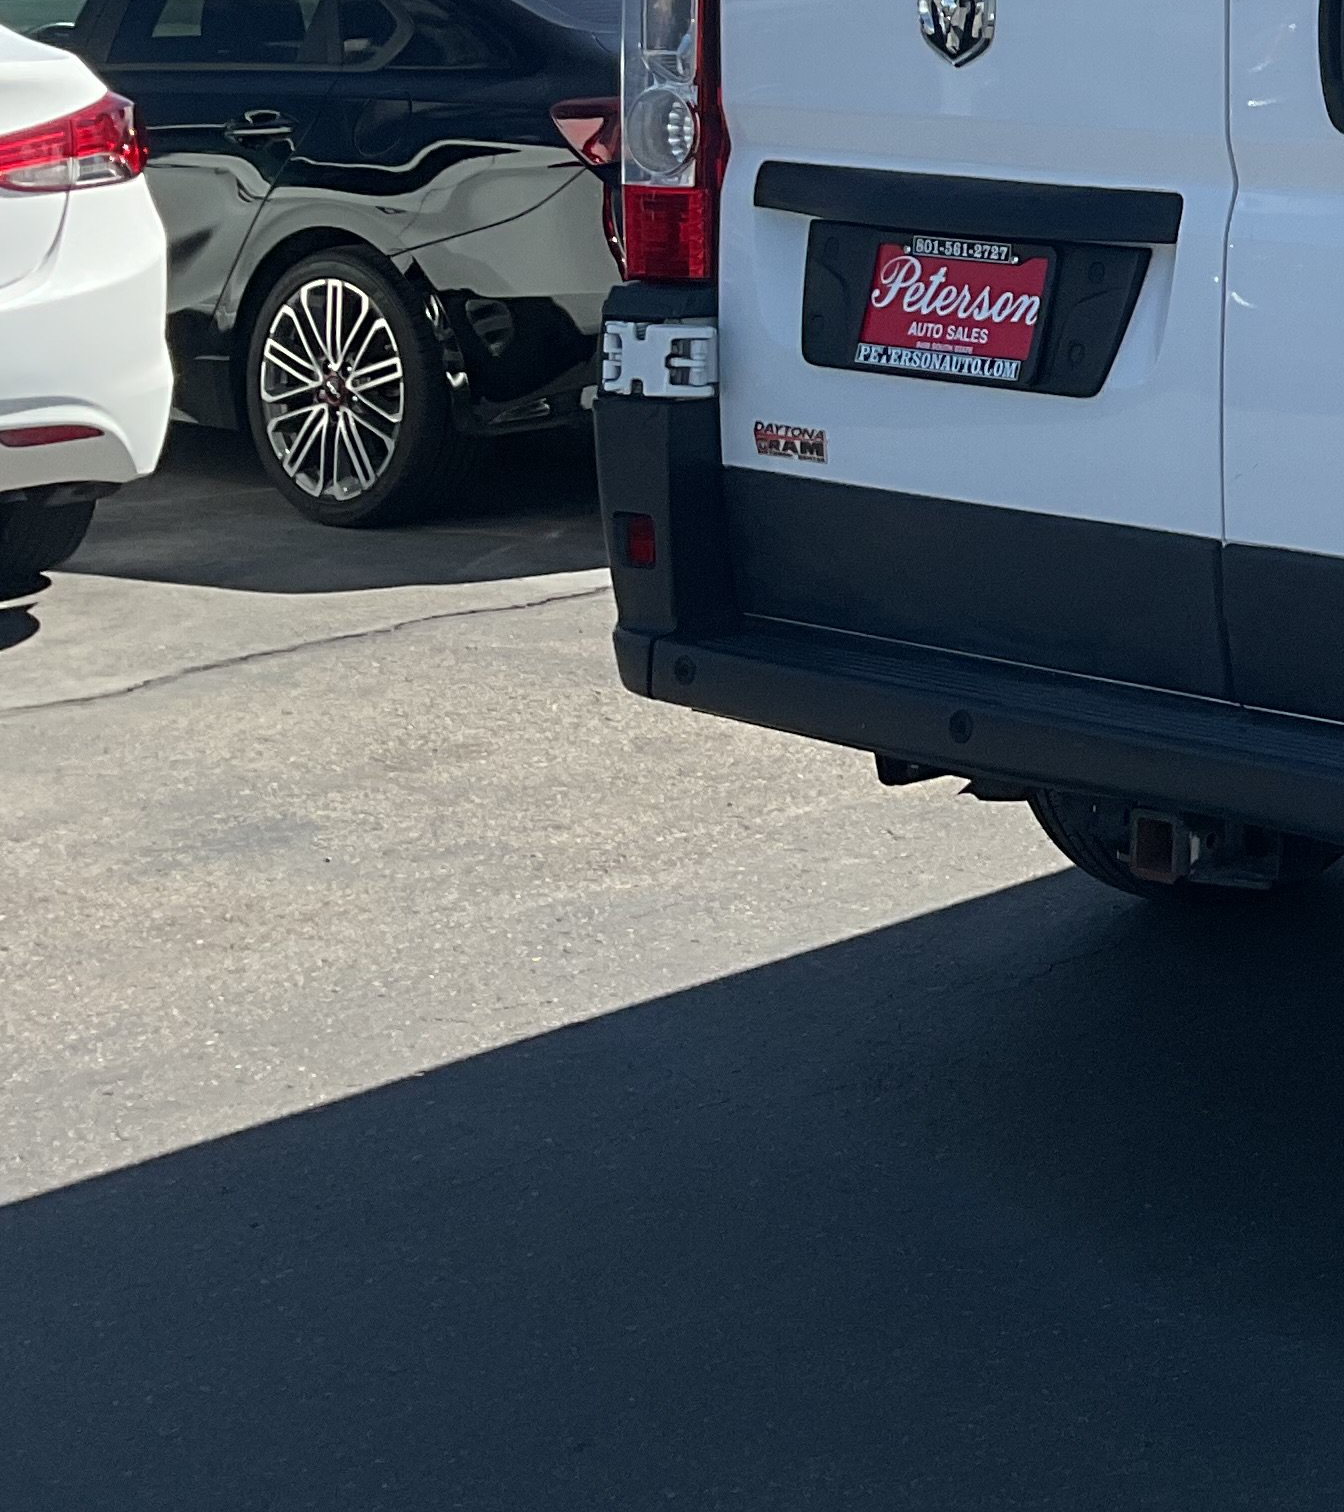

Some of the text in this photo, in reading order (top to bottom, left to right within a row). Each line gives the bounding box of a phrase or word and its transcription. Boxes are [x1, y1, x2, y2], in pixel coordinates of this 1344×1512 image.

[915, 238, 1008, 260] 801-561-2727
[871, 255, 1041, 326] Peterson
[908, 321, 989, 344] AUTO SALES
[754, 420, 824, 441] DAYTONA
